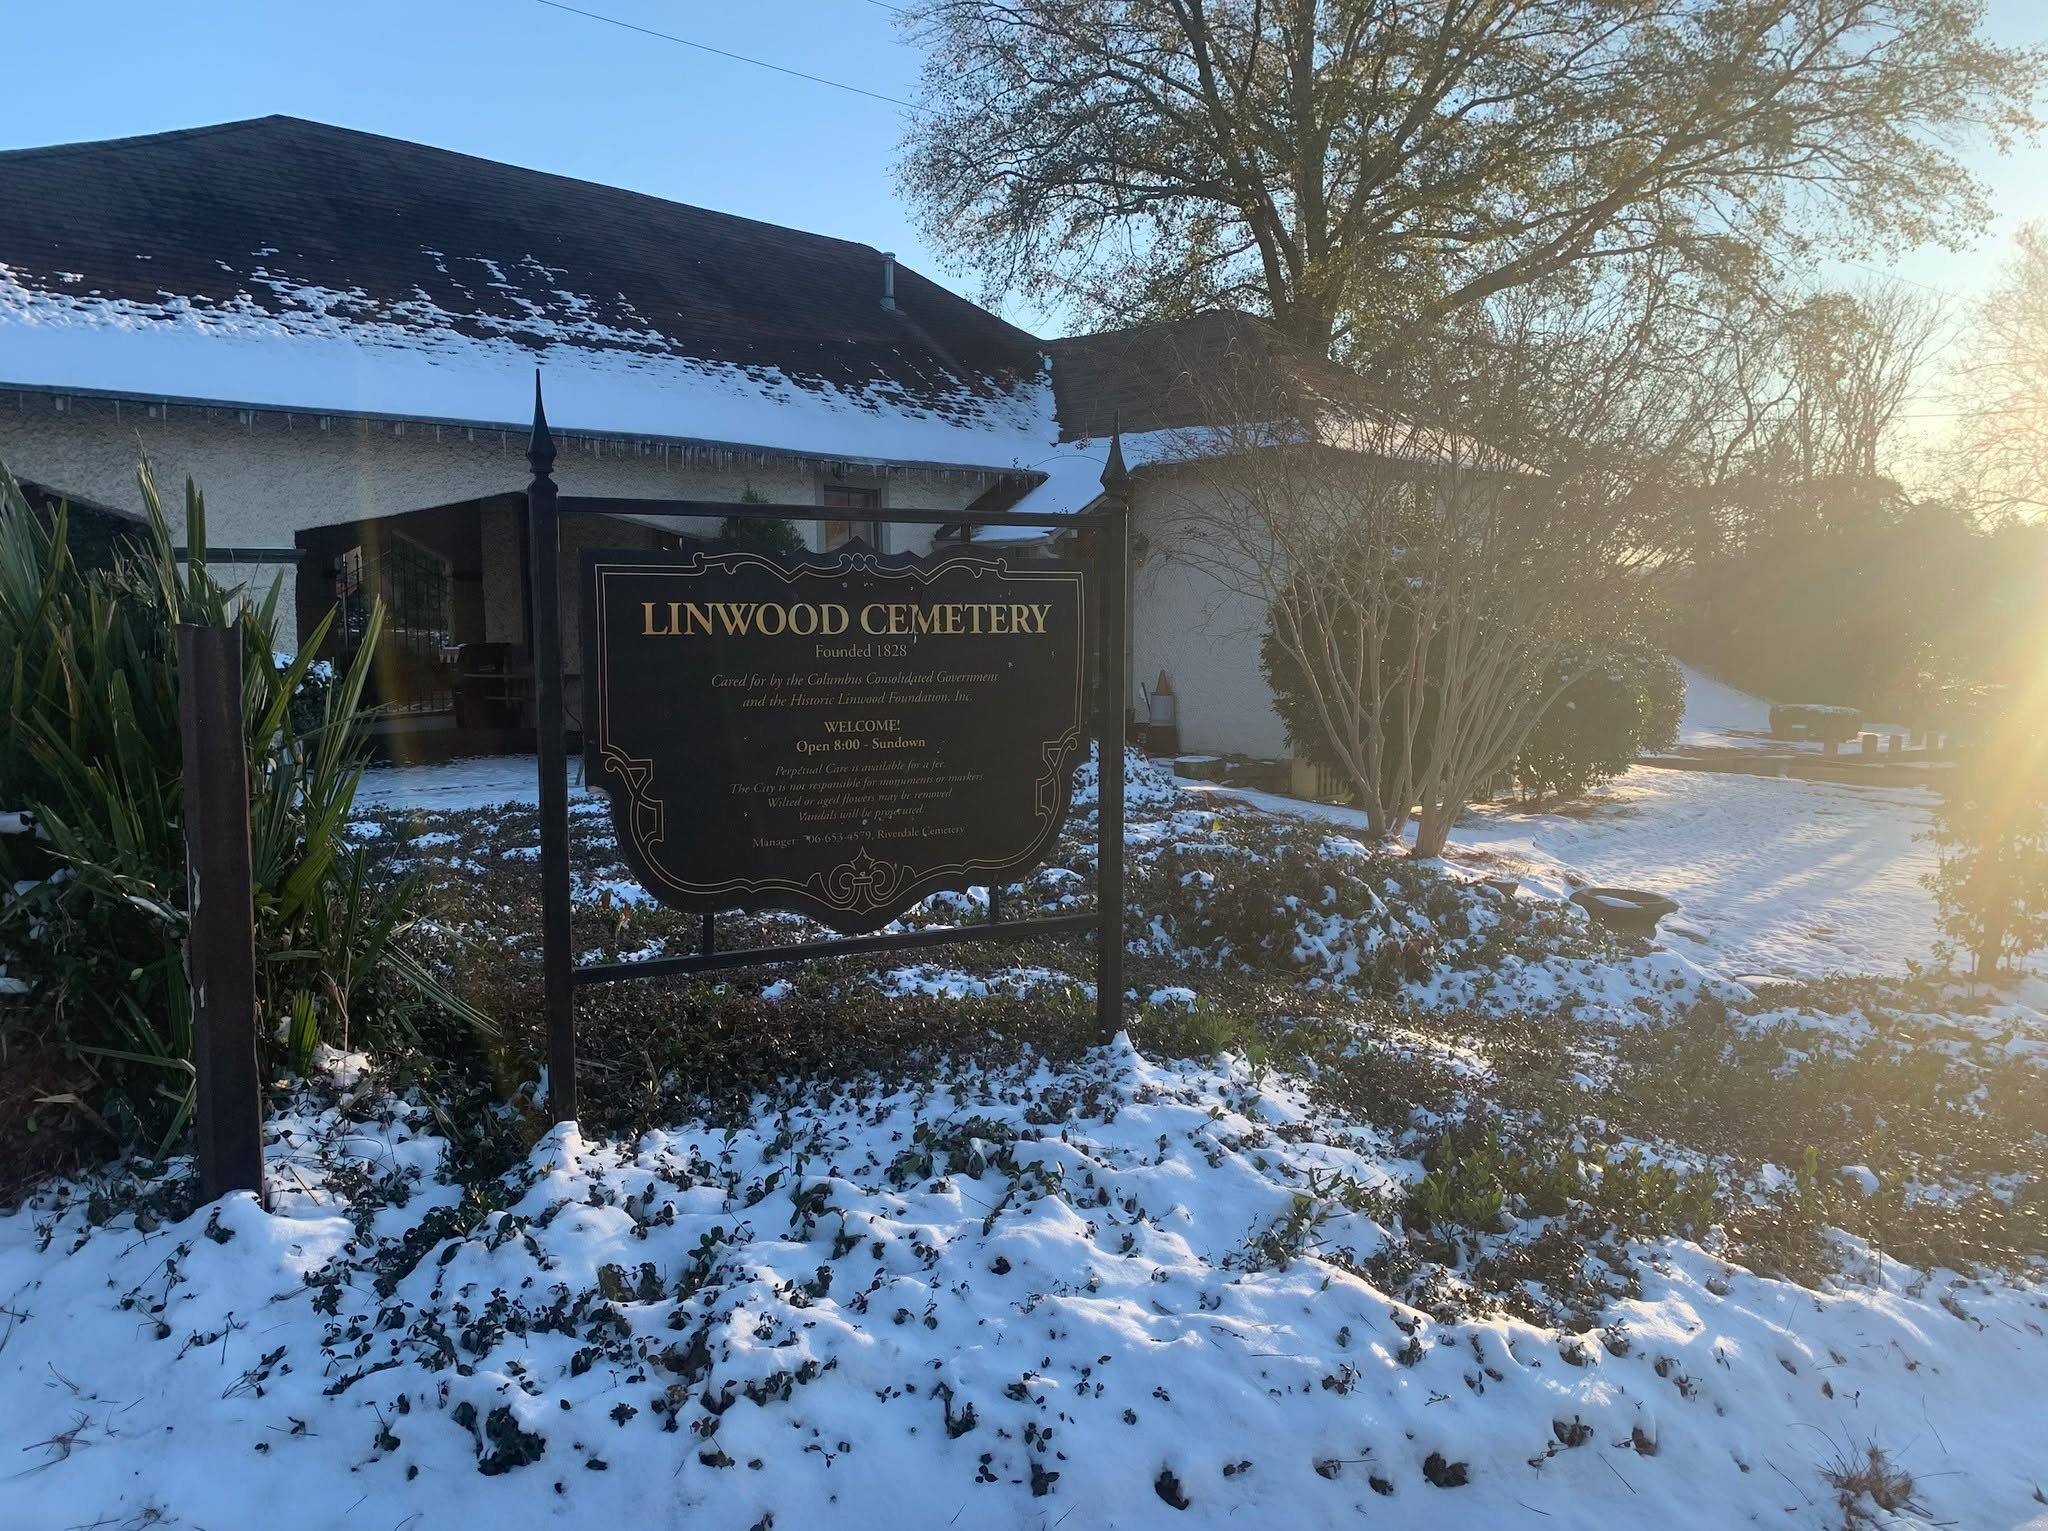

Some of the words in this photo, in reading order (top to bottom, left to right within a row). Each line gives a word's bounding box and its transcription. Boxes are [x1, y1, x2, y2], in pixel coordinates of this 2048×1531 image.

[641, 602, 849, 636] LINWOOD
[860, 603, 1052, 635] CEMETERY
[815, 644, 871, 658] Founded
[876, 644, 907, 657] 1828
[711, 673, 748, 687] Cared
[747, 673, 767, 690] for
[769, 673, 784, 690] by
[786, 673, 803, 686] the
[807, 672, 862, 686] Columbus
[866, 671, 934, 685] Consolidated
[936, 670, 999, 683] Government
[742, 694, 767, 707] and
[769, 694, 787, 706] the
[790, 693, 834, 706] Historic
[838, 691, 886, 705] Linwood
[824, 720, 901, 733] WELCOME!
[796, 740, 830, 756] Open
[834, 738, 861, 751] 8:00
[872, 736, 926, 750] Sundown
[775, 764, 823, 779] Perpetual
[825, 763, 849, 774] Care
[861, 760, 905, 772] available
[907, 759, 921, 772] for
[730, 783, 751, 794] The
[753, 782, 776, 795] City
[778, 784, 787, 792] is
[789, 784, 806, 792] not
[808, 777, 861, 793] responsible
[861, 776, 877, 791] for
[879, 777, 935, 786] monuments
[768, 796, 802, 808] Wilted
[816, 794, 841, 808] aged
[841, 792, 875, 805] flowers
[878, 793, 898, 803] may
[900, 790, 912, 800] be
[799, 810, 838, 821] Vandals
[839, 807, 860, 819] will
[861, 807, 872, 817] be
[877, 827, 920, 840] Riverdale
[921, 824, 965, 837] Cemetery
